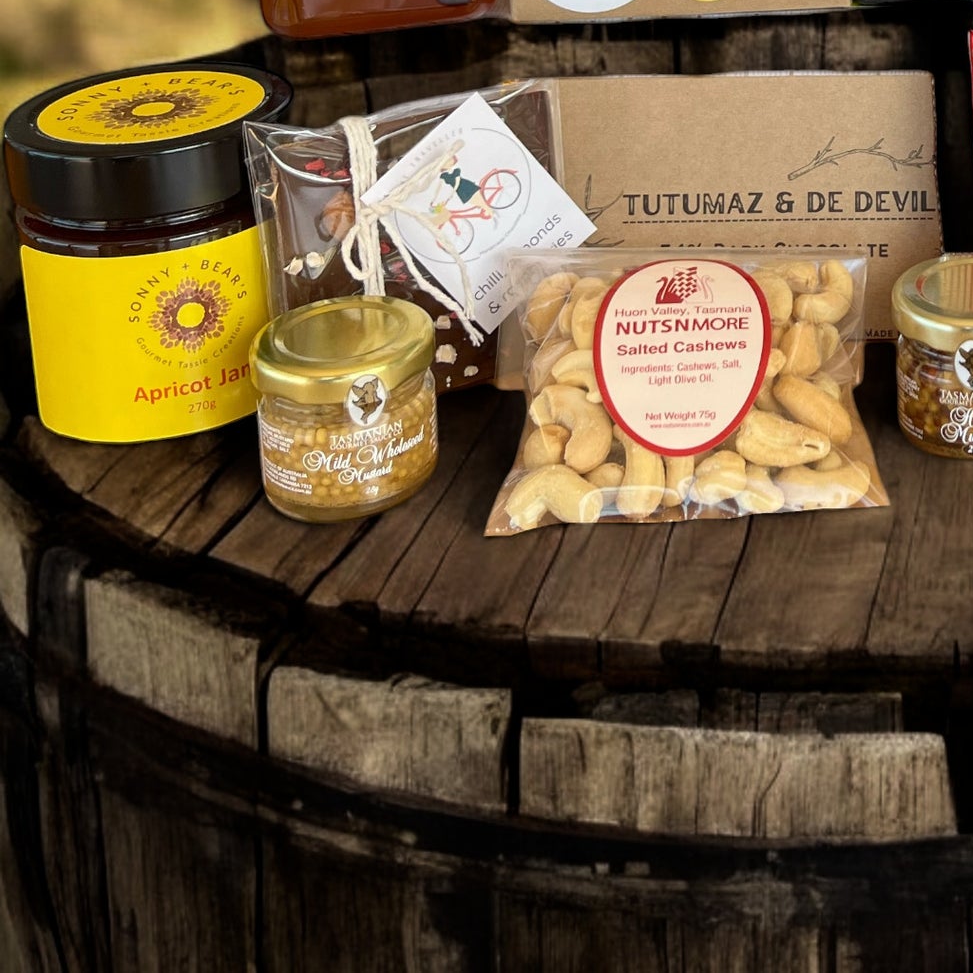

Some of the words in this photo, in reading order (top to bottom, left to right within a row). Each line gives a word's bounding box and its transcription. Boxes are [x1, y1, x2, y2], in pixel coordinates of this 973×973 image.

[56, 86, 122, 121] SONNY
[168, 77, 245, 97] BEAR'S
[68, 125, 122, 139] Gourmet
[132, 128, 180, 137] Tassie
[623, 191, 764, 216] TUTUMAZ
[775, 191, 796, 213] &
[806, 191, 844, 213] DE
[855, 191, 936, 213] DEVIL
[128, 267, 171, 323] SONNY
[182, 262, 190, 270] +
[200, 259, 248, 299] BEAR'S
[488, 301, 502, 314] &
[614, 307, 648, 317] Huon
[651, 306, 690, 317] Valley,
[694, 304, 752, 314] Tasmania
[136, 337, 172, 367] Gourmet
[178, 357, 208, 369] Tassie
[212, 315, 245, 358] Creations
[617, 343, 668, 357] Salted
[674, 339, 747, 353] Cashews
[621, 363, 674, 375] Ingredients:
[676, 361, 719, 373] Cashews,
[134, 375, 212, 405] Apricot
[648, 375, 672, 386] Light
[674, 374, 696, 385] Olive
[699, 373, 714, 383] Oil.
[188, 399, 217, 413] 270g
[645, 413, 662, 421] Net
[664, 411, 696, 421] Weight
[698, 410, 716, 419] 75g
[330, 419, 402, 445] TASMANIAN
[302, 450, 352, 472] Mild
[356, 425, 424, 465] Wholeseed
[338, 461, 393, 485] Mustard
